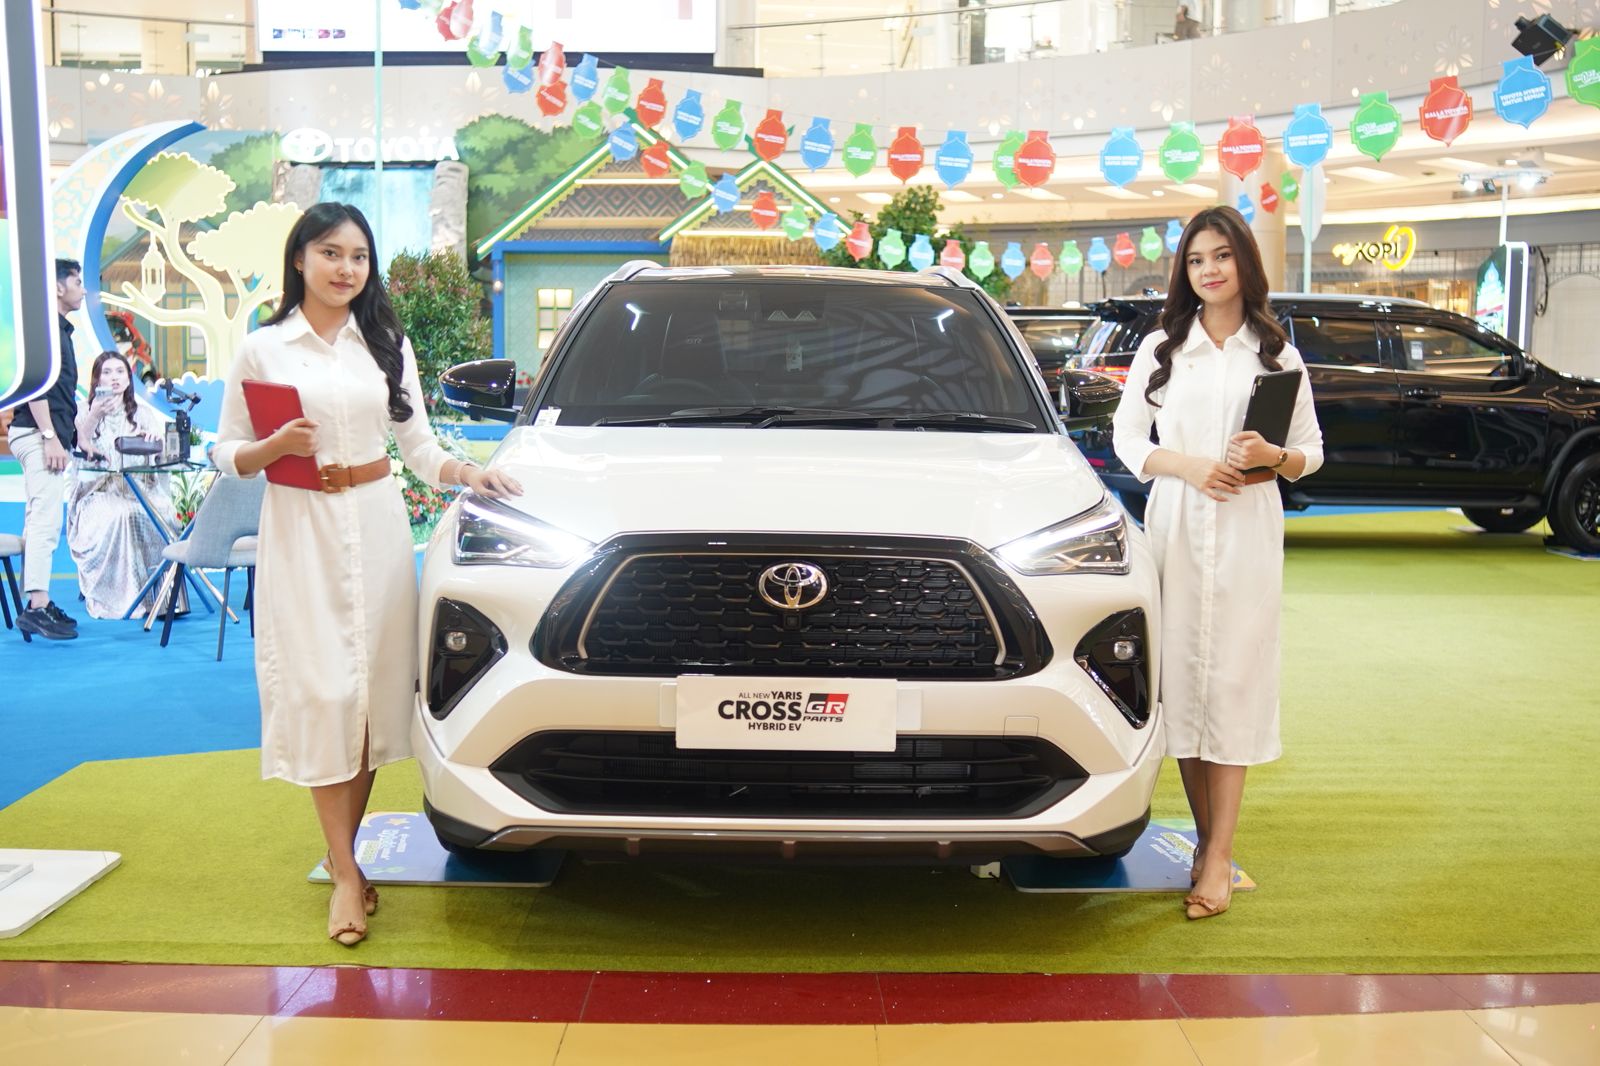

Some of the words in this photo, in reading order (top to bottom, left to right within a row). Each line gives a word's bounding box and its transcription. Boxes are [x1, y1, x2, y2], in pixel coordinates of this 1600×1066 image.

[333, 136, 460, 163] TOYOTA
[771, 691, 803, 700] YARIS
[718, 699, 803, 721] CROSS
[805, 701, 847, 714] GR
[802, 715, 844, 723] PARTS
[748, 722, 787, 731] HYBRID
[788, 722, 802, 731] EV
